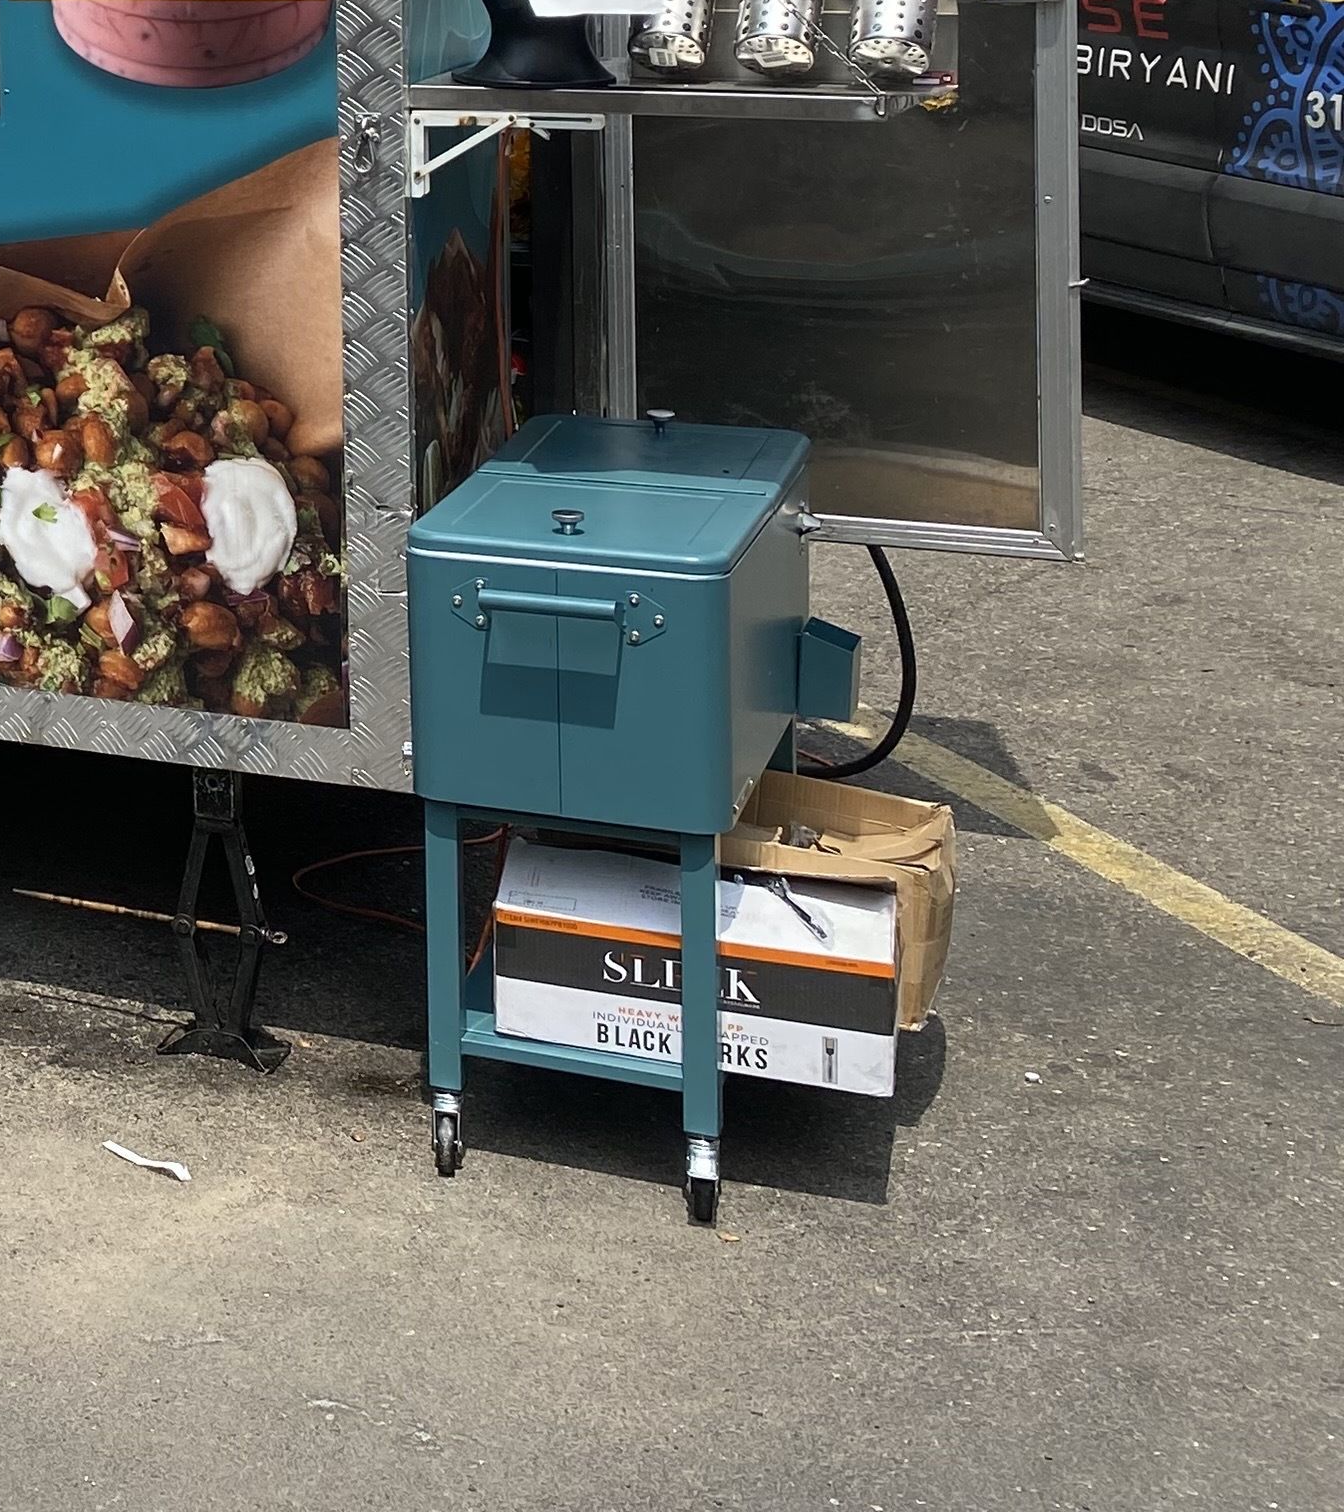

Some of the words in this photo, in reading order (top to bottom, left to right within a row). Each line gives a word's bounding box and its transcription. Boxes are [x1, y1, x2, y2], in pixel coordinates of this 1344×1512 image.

[1076, 44, 1235, 95] BIRYANI
[1081, 114, 1144, 142] DOSA
[603, 950, 761, 1005] SLEK
[592, 1010, 682, 1033] INDIVIDUALL
[720, 1031, 769, 1046] APPED
[618, 1006, 661, 1020] HEAVY
[597, 1022, 672, 1055] BLACK
[721, 1043, 769, 1070] RKS
